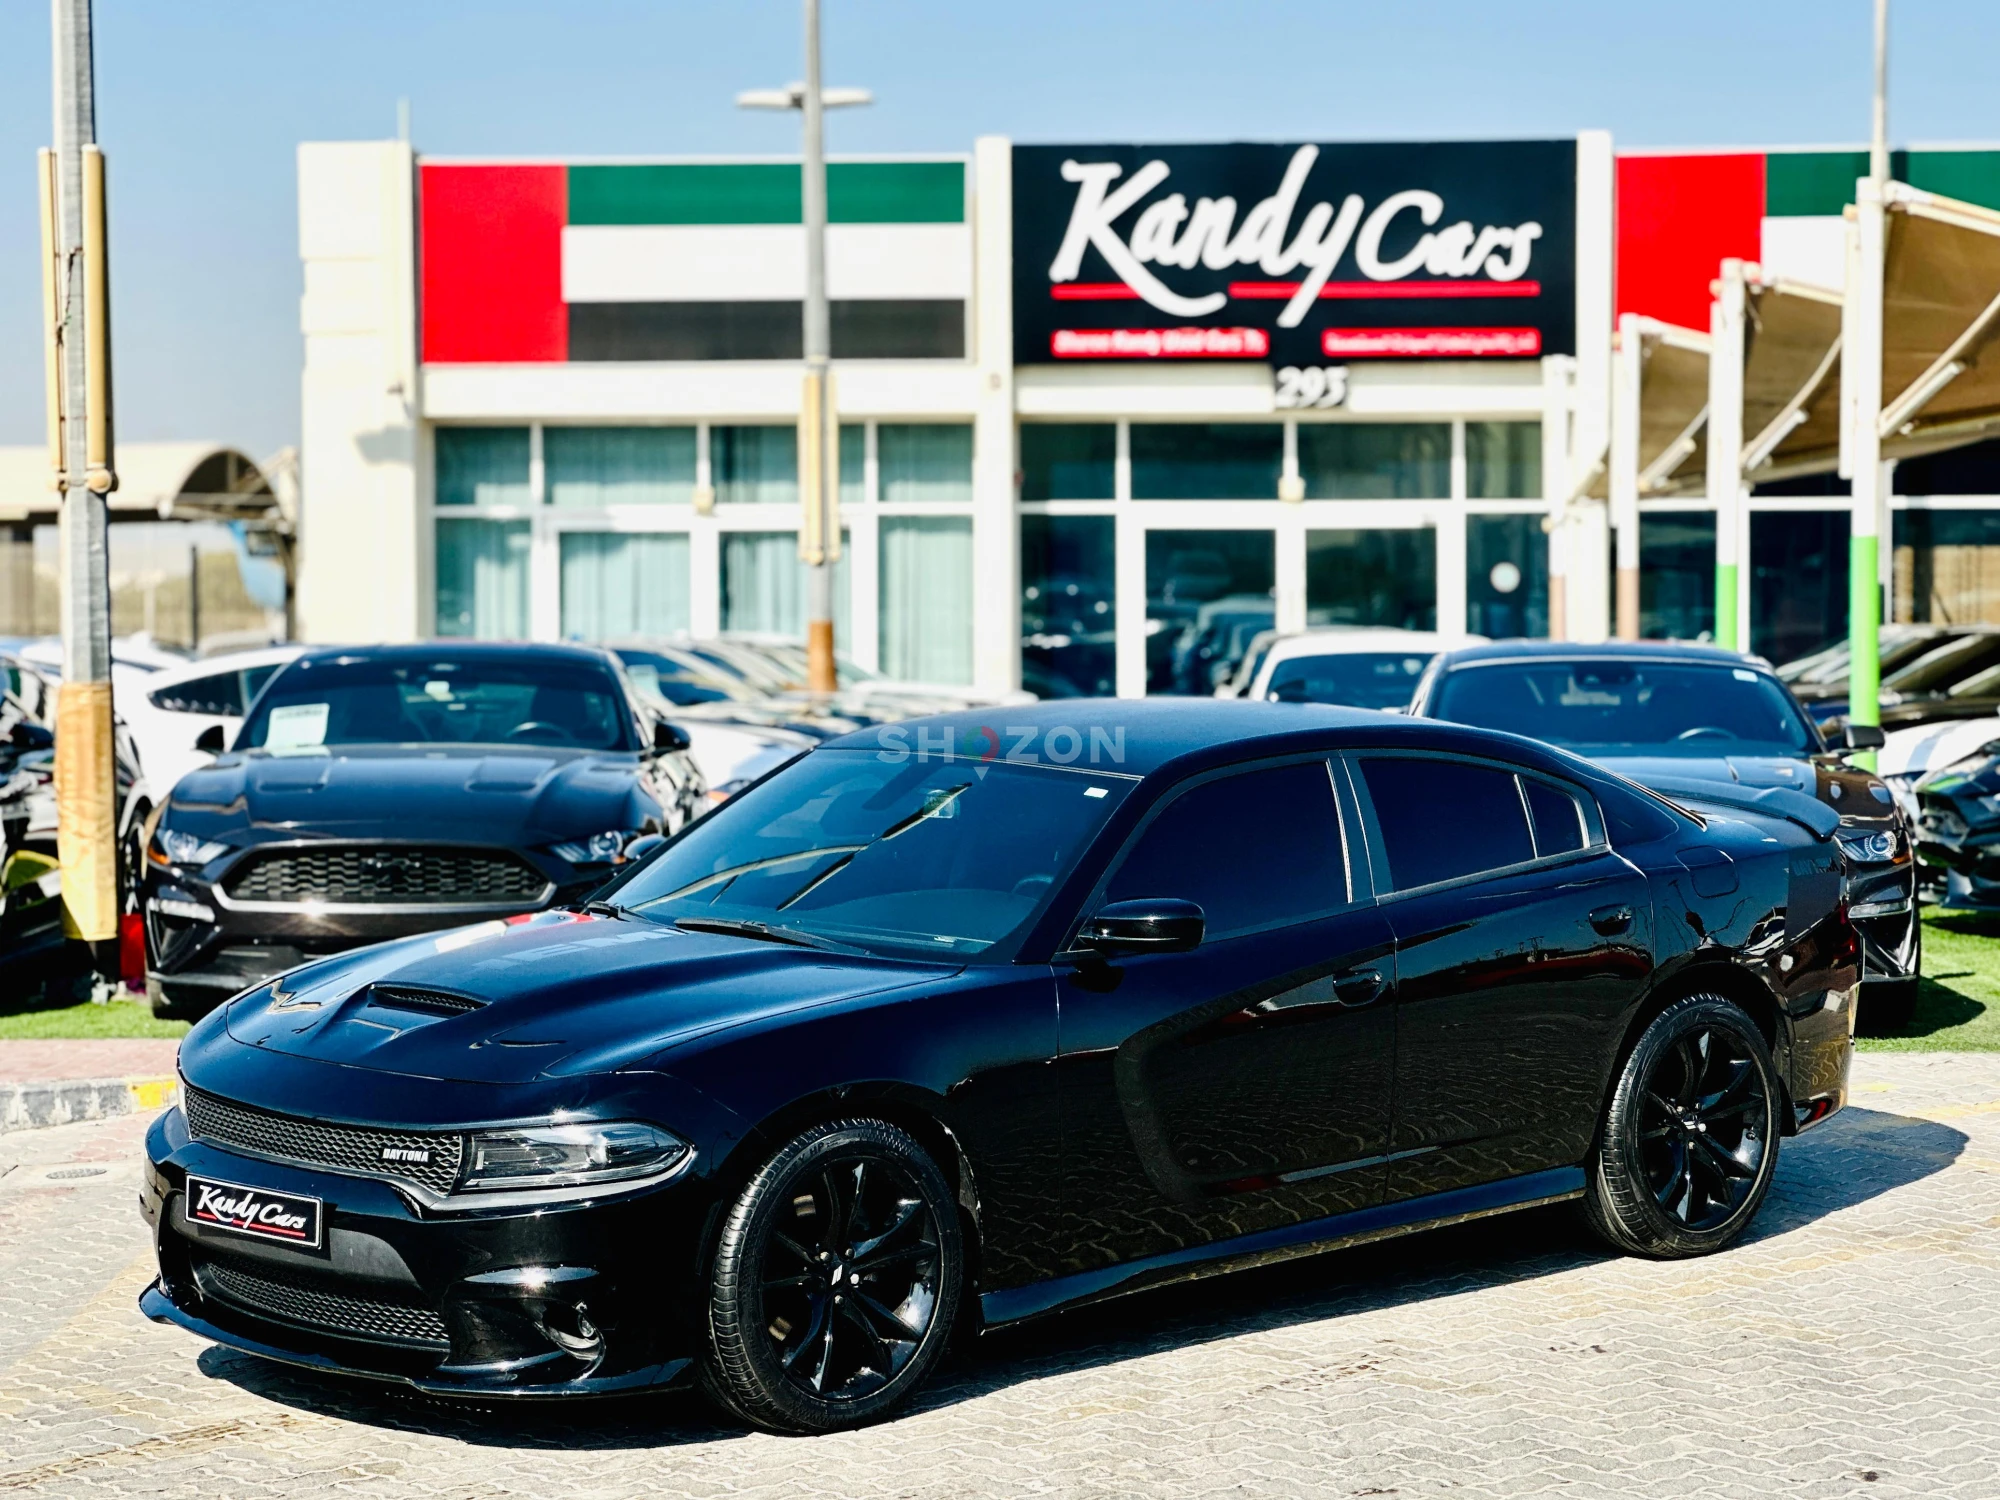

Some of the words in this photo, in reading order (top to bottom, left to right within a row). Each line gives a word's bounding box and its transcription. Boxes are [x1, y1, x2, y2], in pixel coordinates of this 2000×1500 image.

[1049, 144, 1364, 327] Kandy
[1355, 189, 1543, 282] Cars
[1275, 365, 1349, 408] 295
[382, 1148, 429, 1162] DAYTONA
[197, 1184, 261, 1229] Kandy
[258, 1203, 307, 1229] Cars
